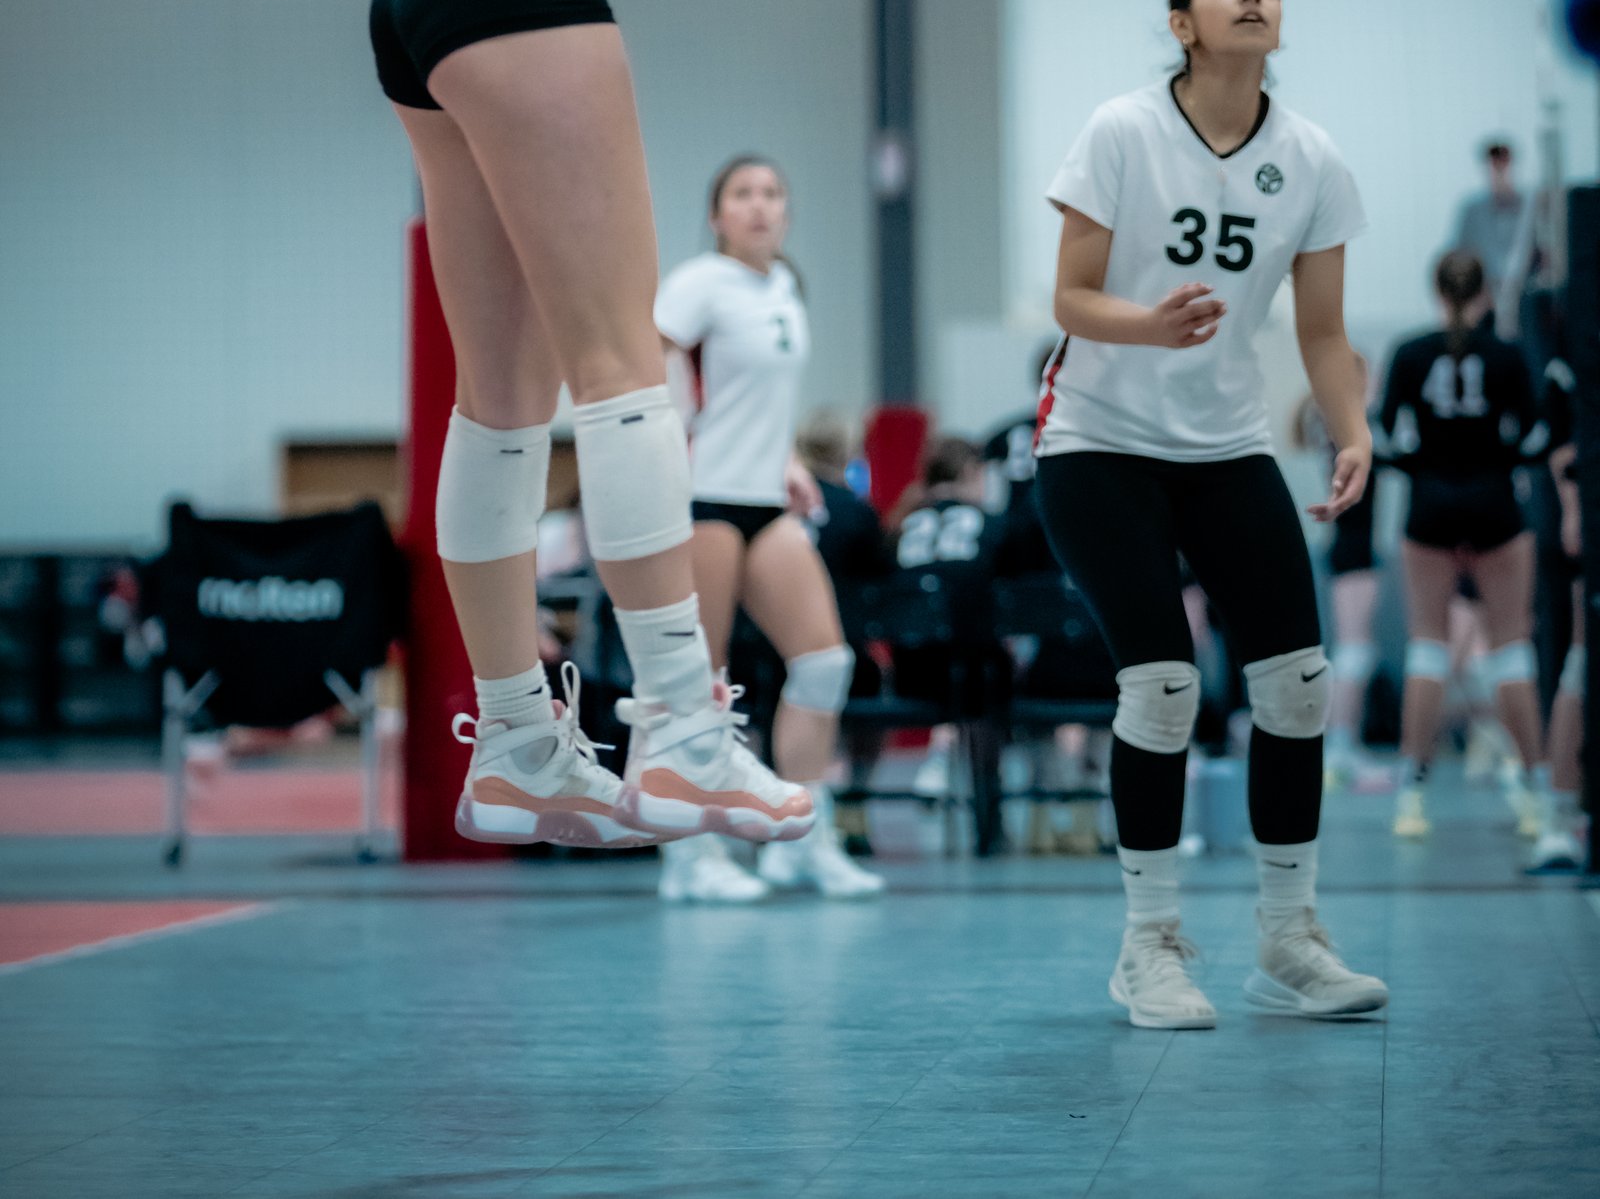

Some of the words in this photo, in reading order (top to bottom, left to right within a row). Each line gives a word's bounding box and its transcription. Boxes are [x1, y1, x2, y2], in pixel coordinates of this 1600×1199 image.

[1166, 207, 1256, 272] 35
[1421, 353, 1489, 419] 41
[897, 504, 984, 569] 22
